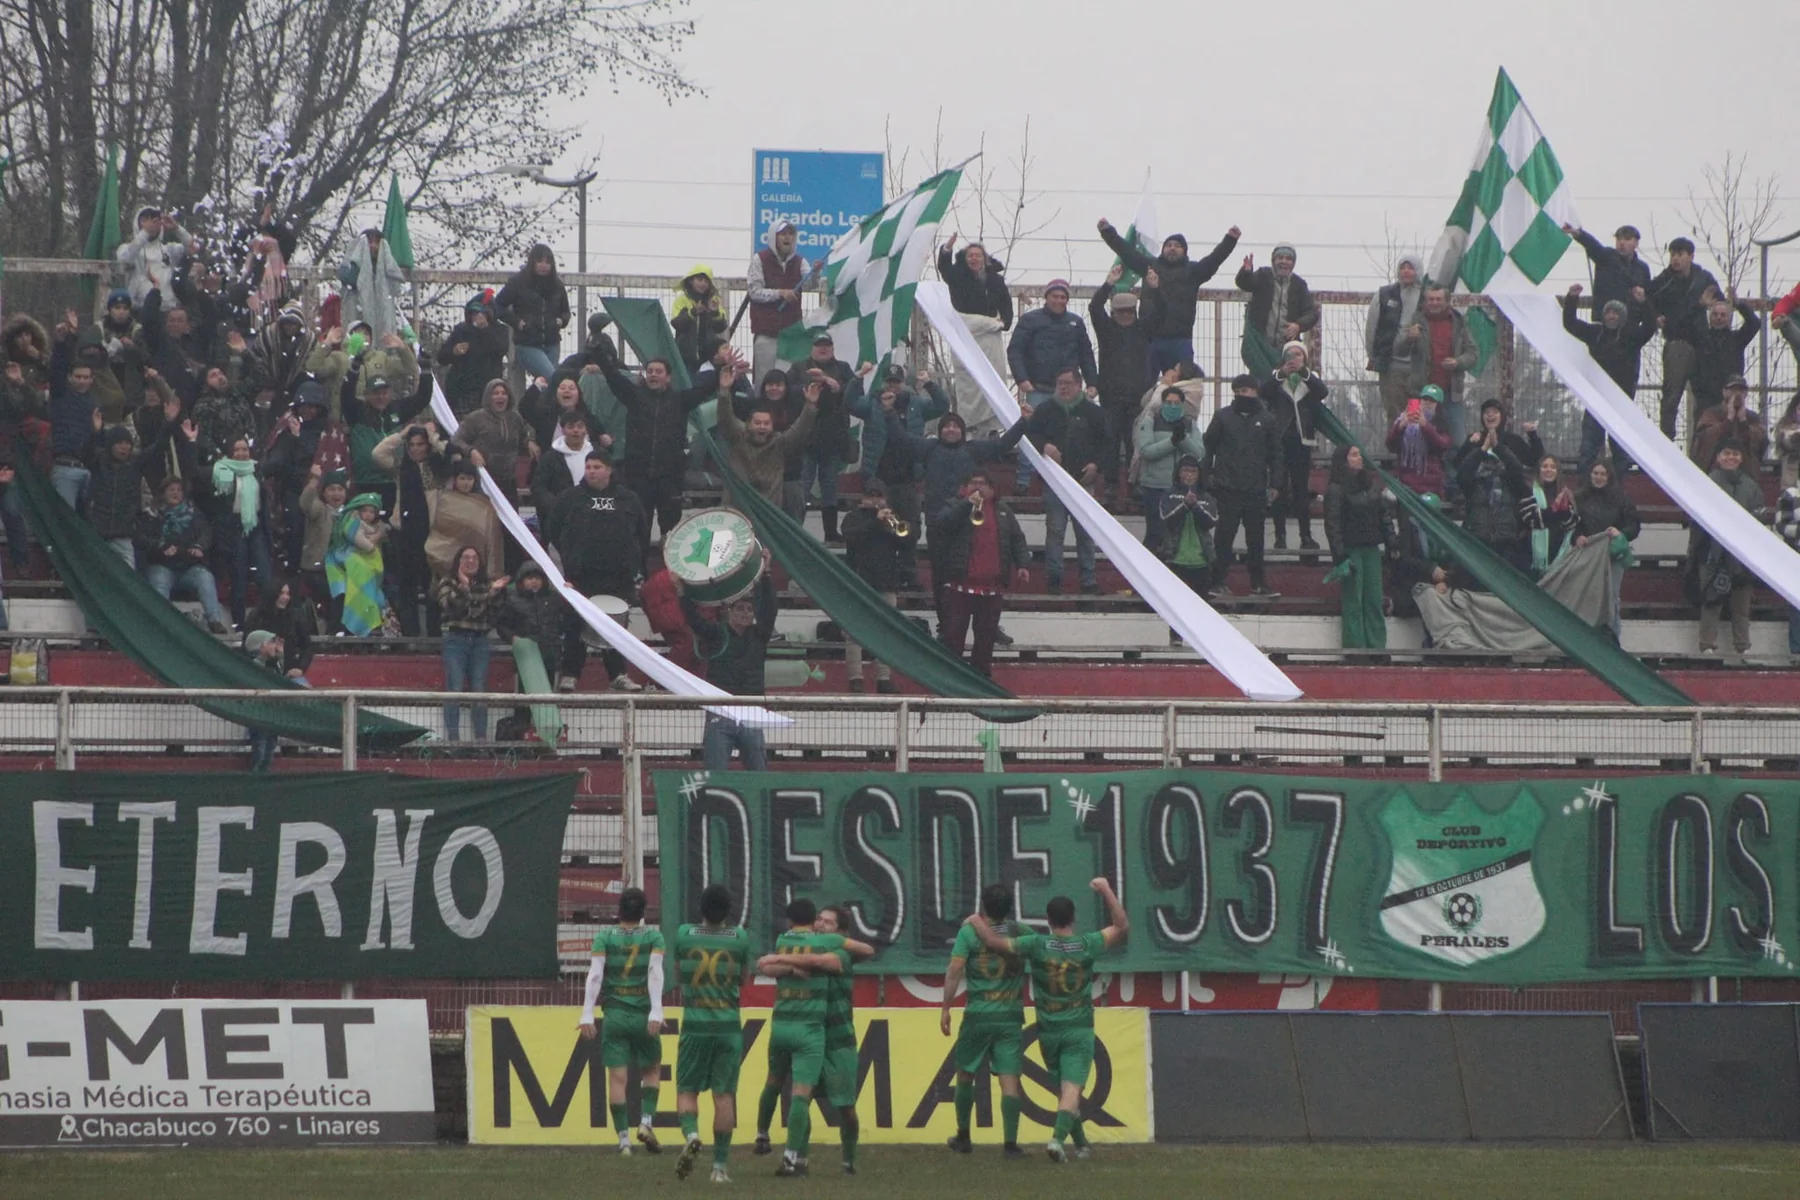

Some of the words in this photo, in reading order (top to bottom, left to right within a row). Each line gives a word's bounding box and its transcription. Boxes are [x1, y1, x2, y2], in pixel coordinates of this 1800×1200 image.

[761, 192, 803, 203] GALERÍA
[1441, 825, 1481, 837] CLUB
[1416, 837, 1507, 850] DEPORTIVO
[33, 801, 504, 955] ETERNO
[685, 785, 1053, 953] DESDE
[1082, 782, 1346, 952] 1937
[1592, 791, 1774, 956] LOS
[1474, 870, 1486, 881] DE
[1486, 862, 1507, 876] 1937
[1420, 934, 1509, 948] PERALES
[622, 944, 640, 980] 7
[0, 1008, 375, 1081] -MET
[83, 1084, 189, 1109] Médica
[199, 1084, 371, 1111] Terapéutica
[82, 1117, 217, 1137] Chacabuco
[225, 1117, 270, 1136] 760
[297, 1116, 380, 1136] Linares
